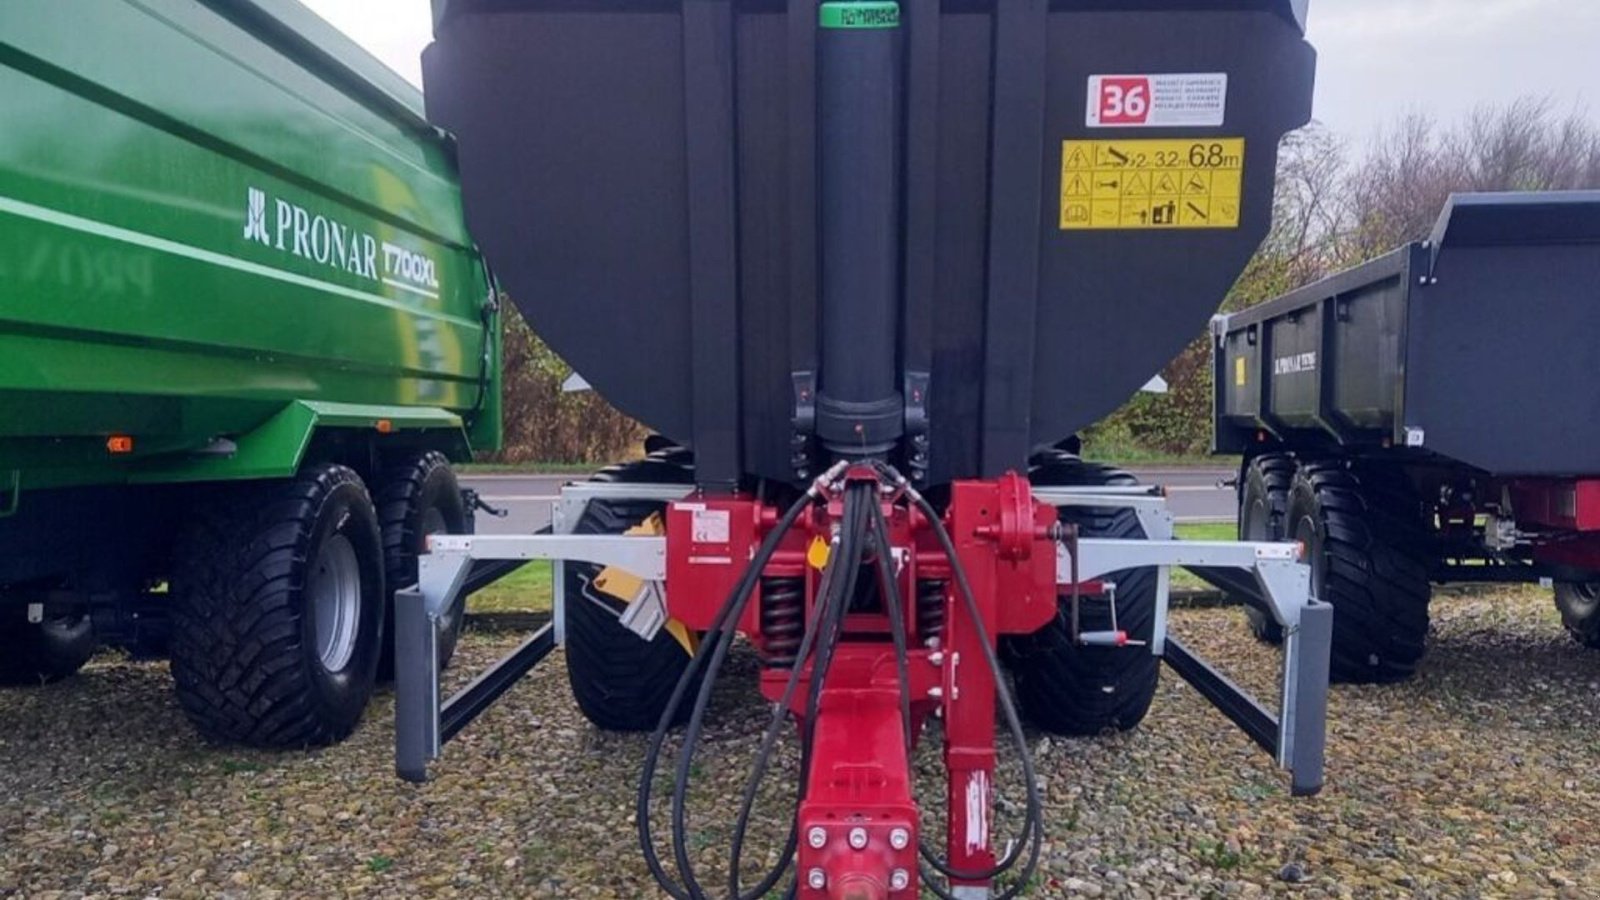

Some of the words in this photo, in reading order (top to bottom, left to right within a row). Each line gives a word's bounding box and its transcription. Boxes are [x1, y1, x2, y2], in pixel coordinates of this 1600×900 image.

[1102, 85, 1146, 117] 36
[275, 198, 378, 280] PRONAR
[381, 241, 439, 289] T700XL
